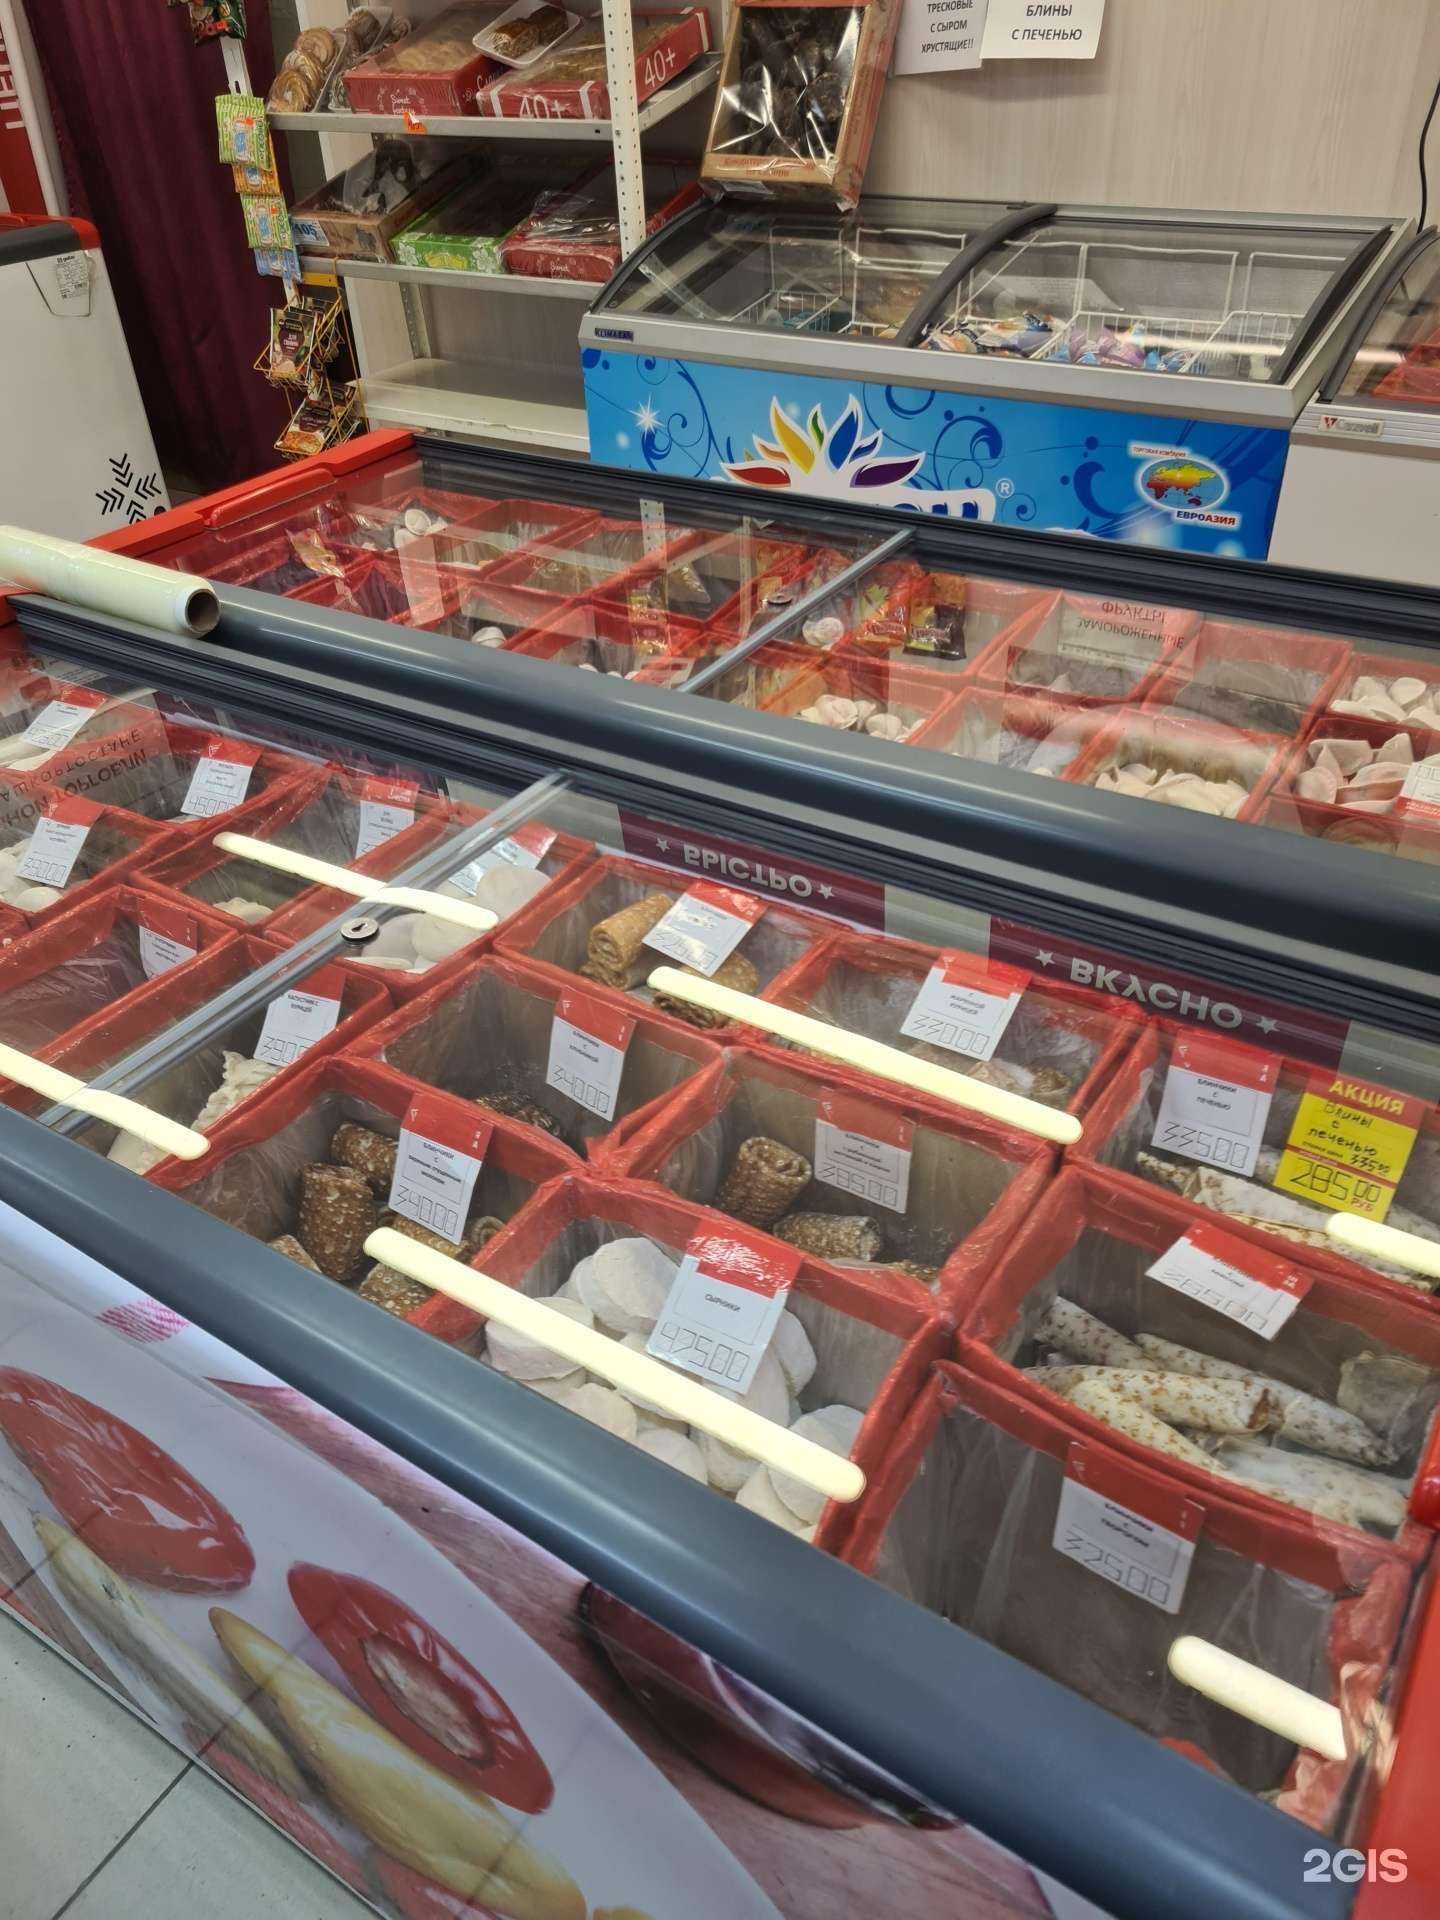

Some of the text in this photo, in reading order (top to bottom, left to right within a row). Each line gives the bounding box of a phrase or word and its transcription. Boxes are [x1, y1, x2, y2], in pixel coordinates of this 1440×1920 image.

[927, 0, 974, 14] ТРЕСКОВЫЕ
[1026, 4, 1073, 17] БЛИНЫ
[930, 20, 968, 33] С СЫРОМ
[1011, 29, 1083, 41] С ПЕЧЕНЬЮ
[921, 38, 974, 54] ХРУСТЯЩИЕ!!
[644, 49, 676, 88] 40+
[1176, 510, 1236, 526] ЕВРОАЗИЯ
[1328, 1080, 1405, 1115] АКЦИЯ
